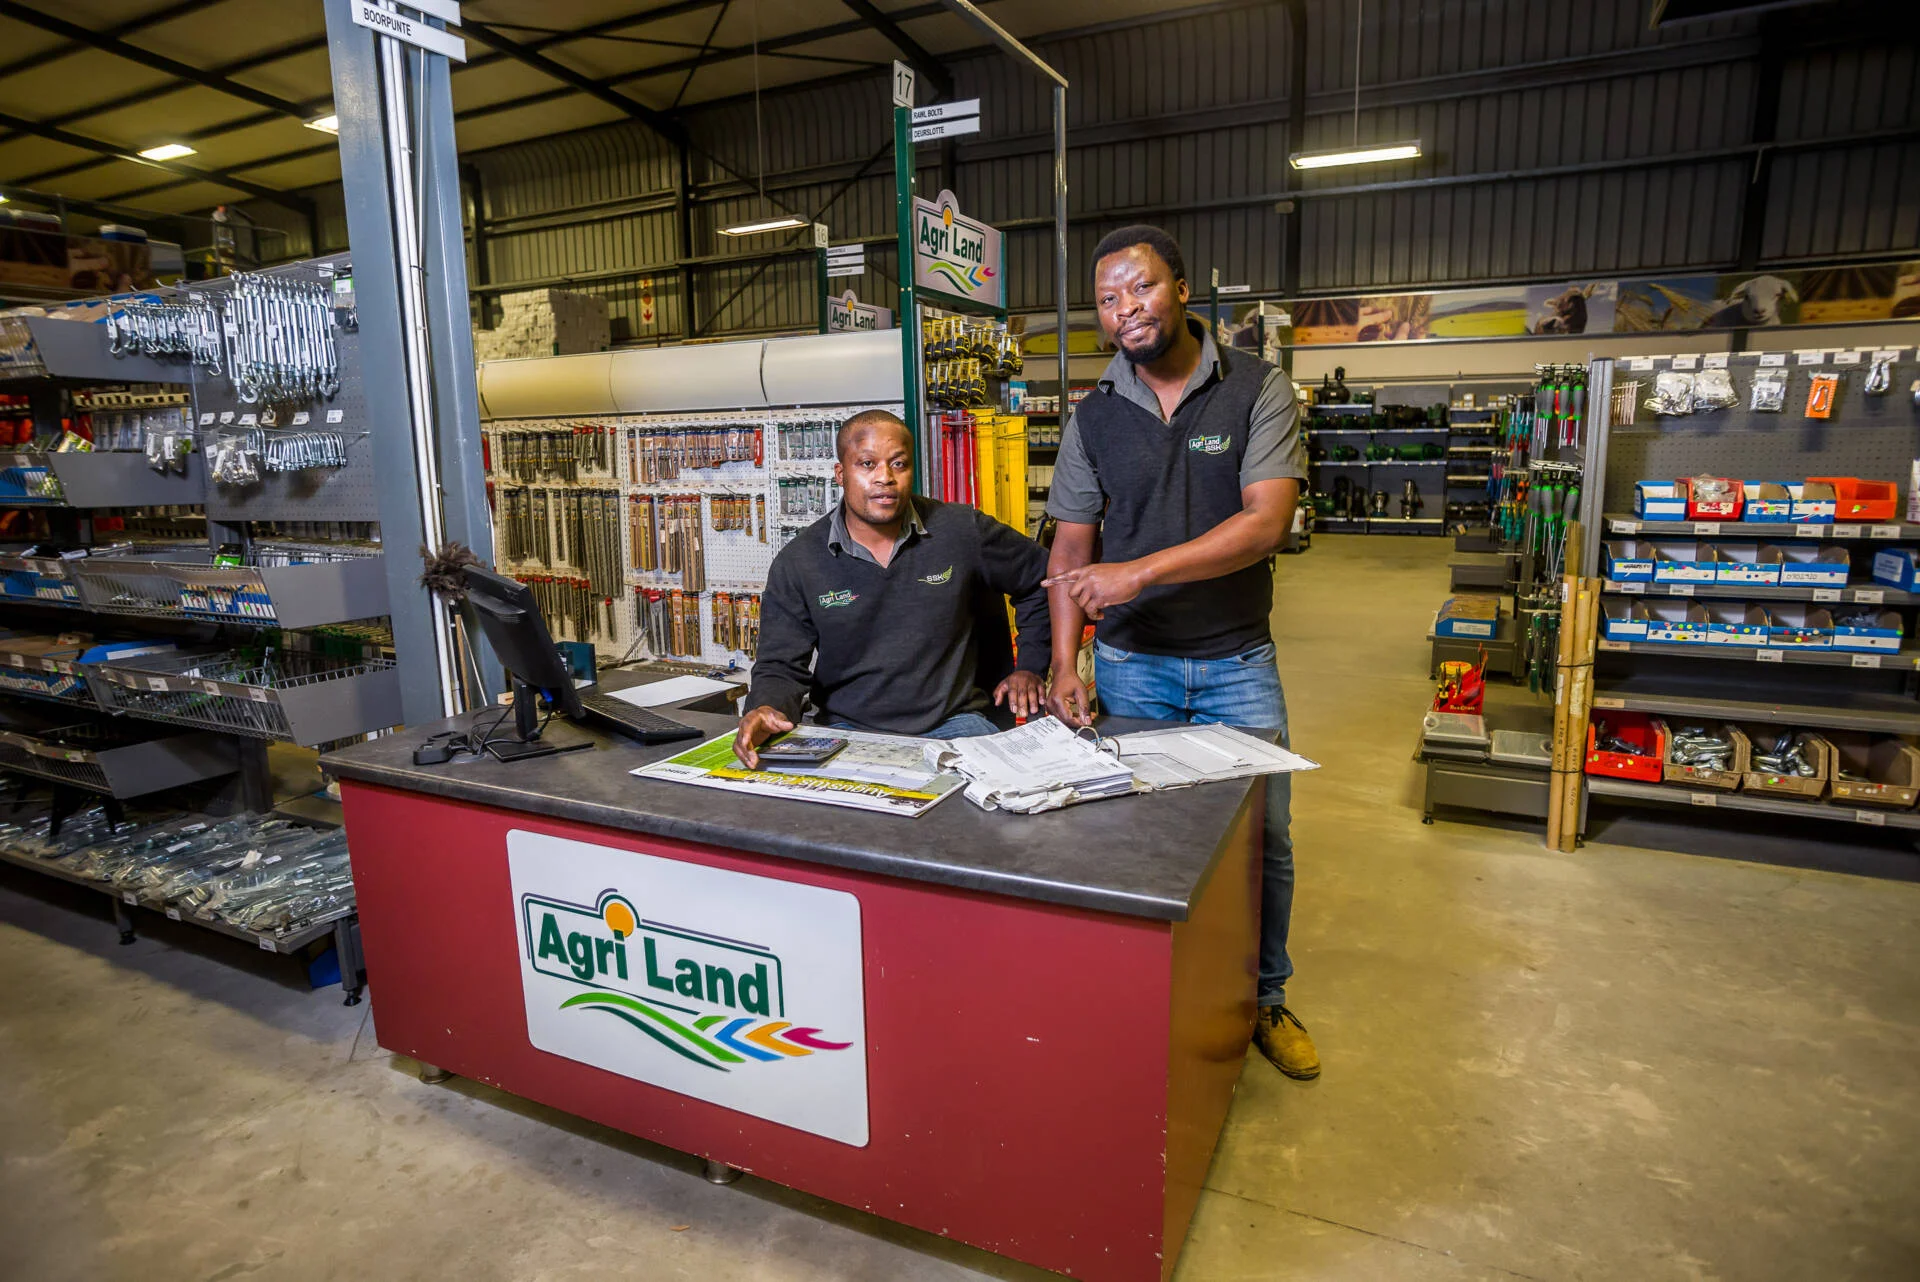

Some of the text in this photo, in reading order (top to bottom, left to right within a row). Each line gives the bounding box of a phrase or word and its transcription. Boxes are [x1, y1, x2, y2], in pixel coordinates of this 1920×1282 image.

[363, 7, 412, 36] BOORPUNTE
[896, 70, 913, 99] 17
[928, 107, 943, 117] BOLTS
[914, 126, 945, 138] DEURSLOTTE
[920, 215, 983, 264] Agri Land
[832, 306, 876, 329] Agri Land
[926, 574, 944, 582] SSK
[821, 592, 851, 604] Agri Land
[743, 772, 895, 799] Augustus 2020
[538, 912, 771, 1017] Agri Land
